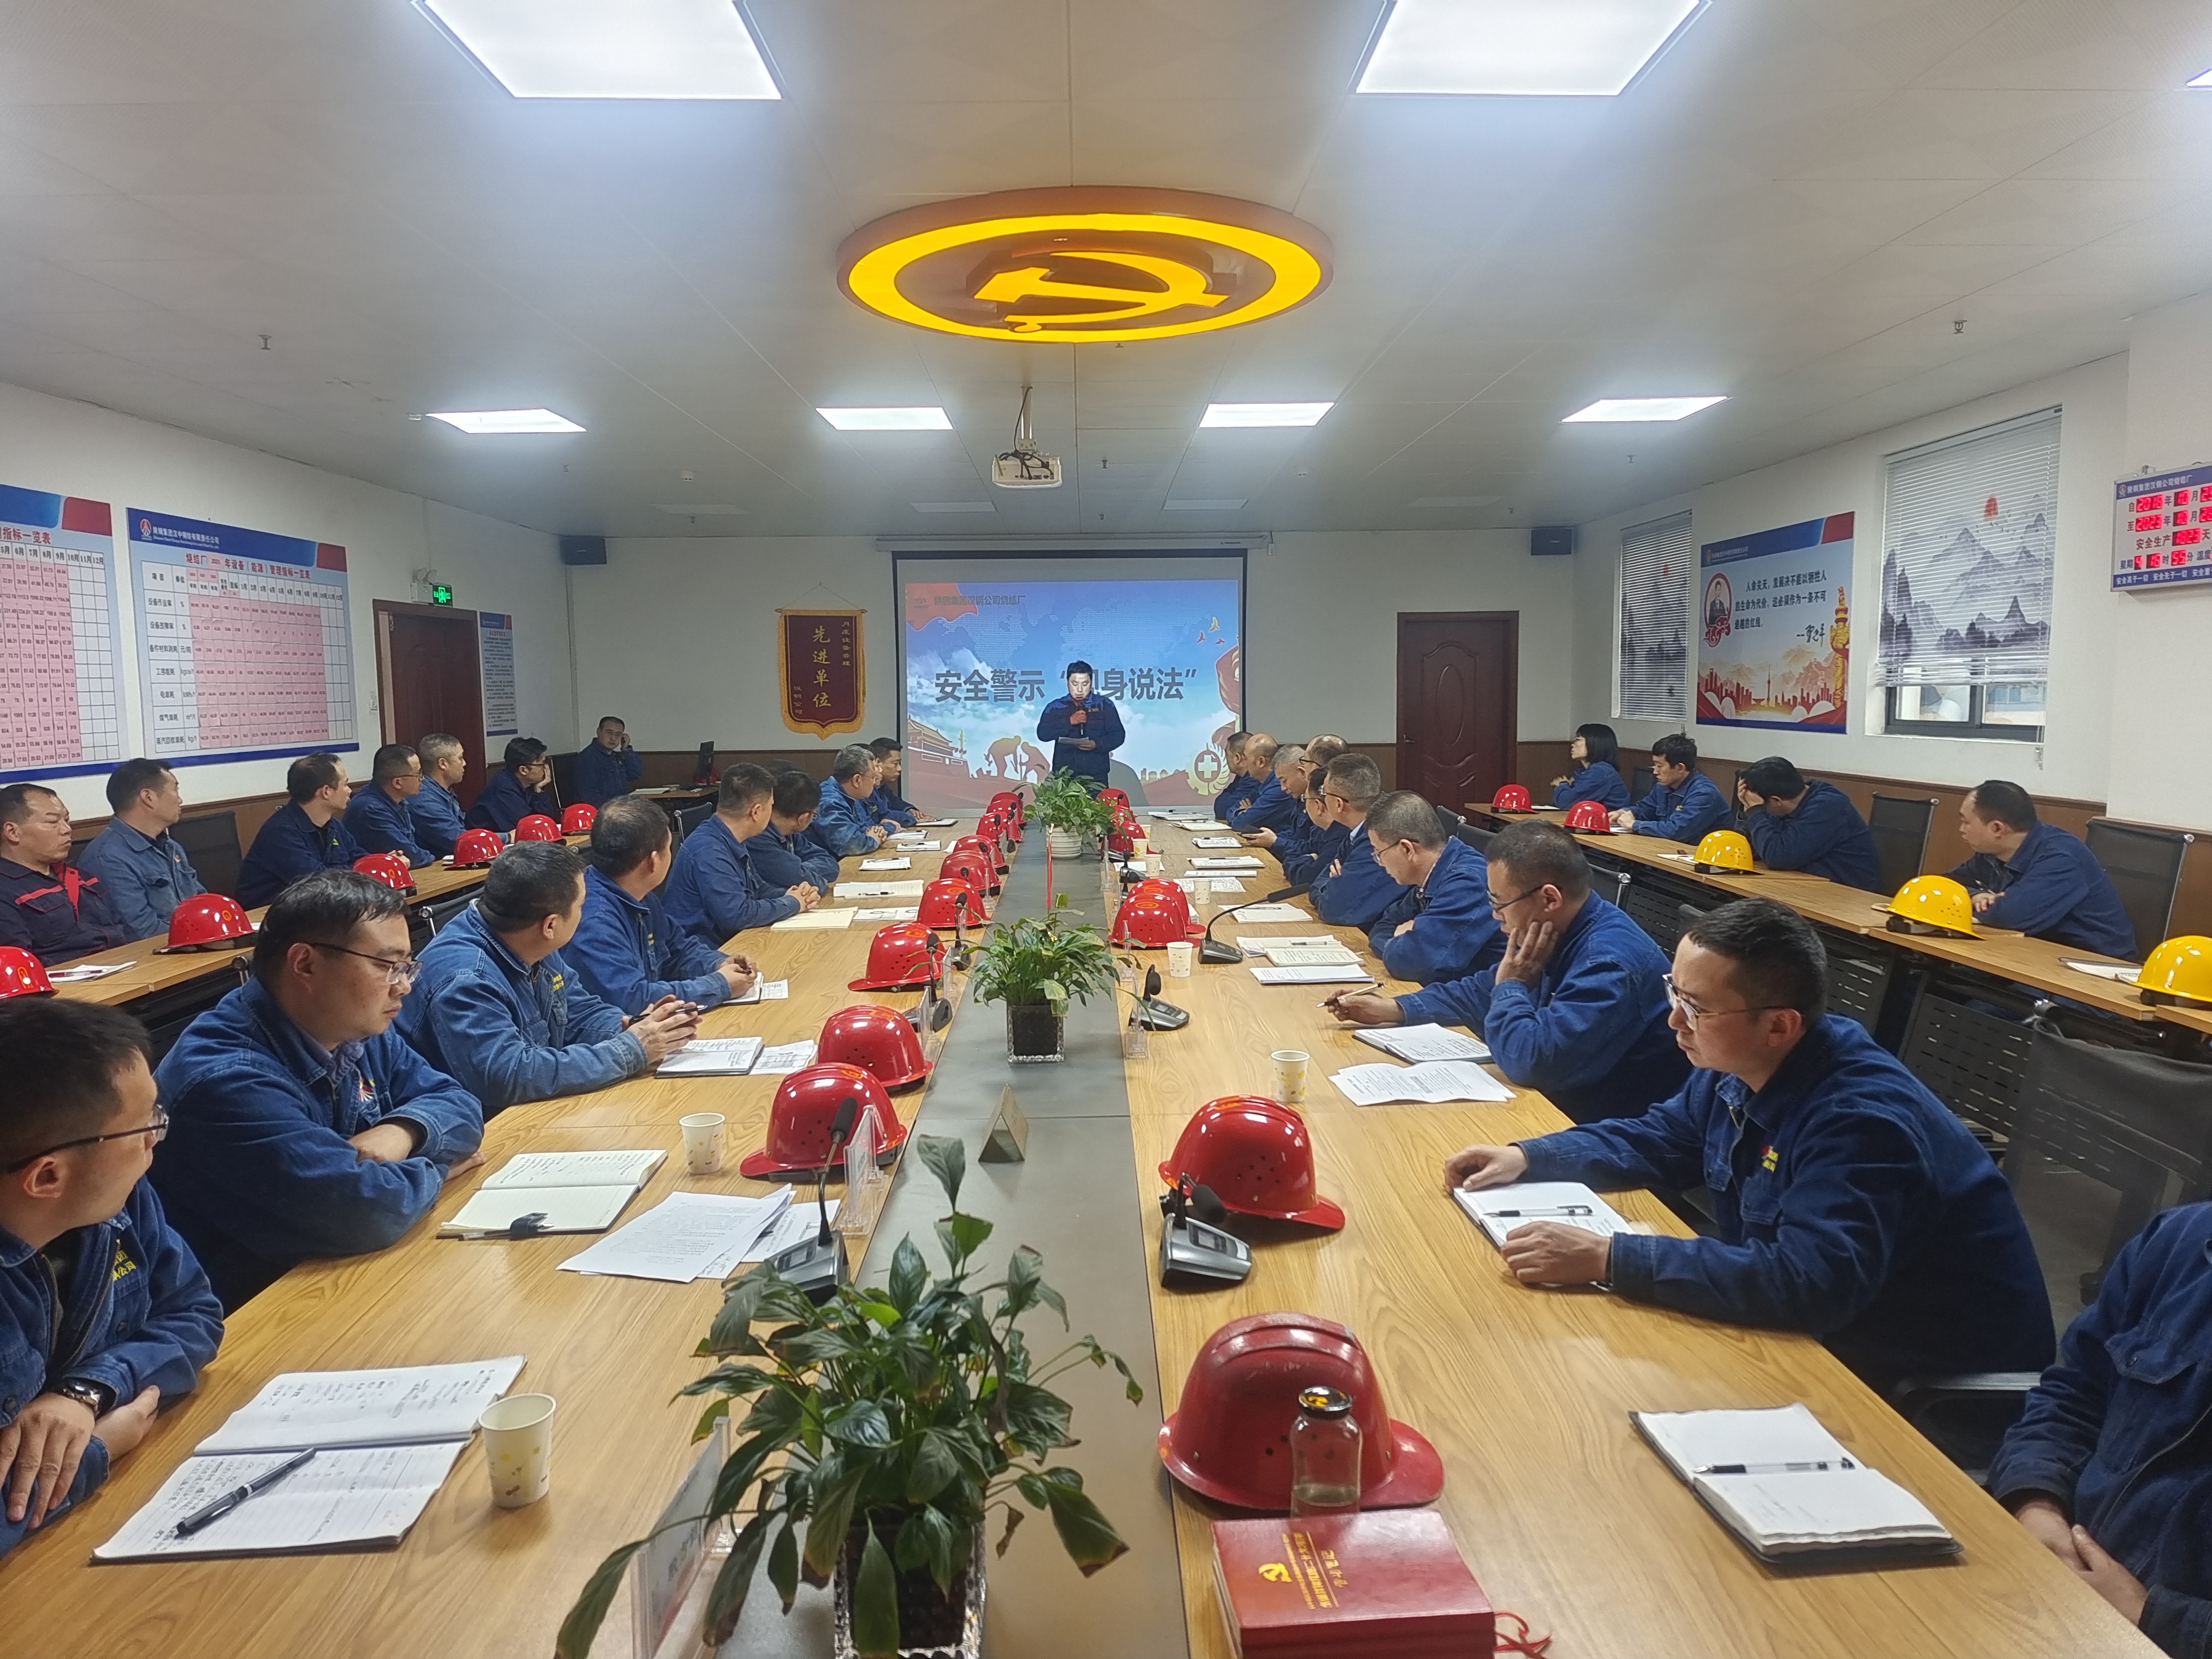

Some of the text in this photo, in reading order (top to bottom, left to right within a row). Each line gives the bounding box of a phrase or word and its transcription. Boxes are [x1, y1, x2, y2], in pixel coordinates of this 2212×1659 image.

[68, 554, 79, 562] 10月
[80, 555, 91, 564] 11月
[2192, 566, 2212, 577] 安全重
[1745, 570, 1827, 592] 人命关天，发展决不能以牺牲人
[934, 594, 1026, 606] 陕钢集团汉钢公司烧结厂
[841, 621, 851, 666] 月度设备管理
[812, 625, 832, 709] 先进单位
